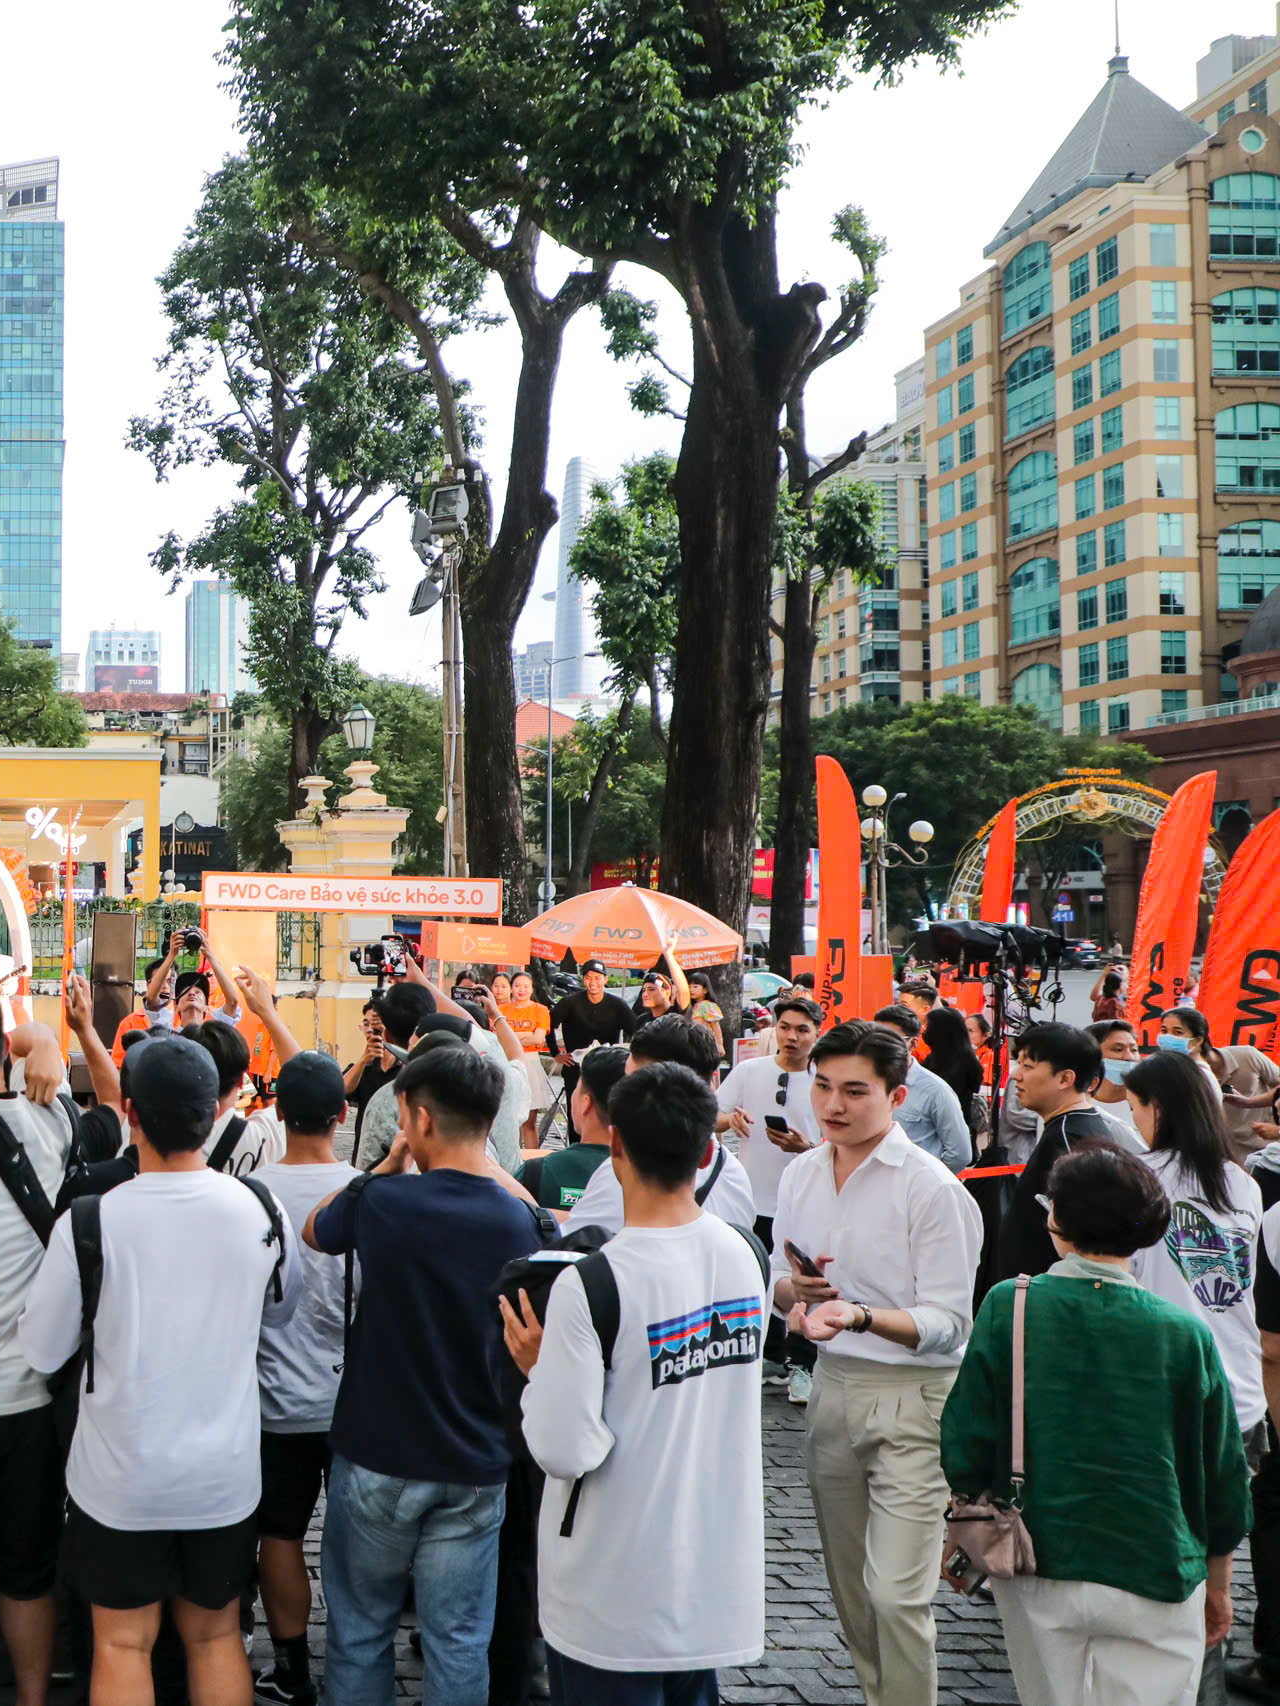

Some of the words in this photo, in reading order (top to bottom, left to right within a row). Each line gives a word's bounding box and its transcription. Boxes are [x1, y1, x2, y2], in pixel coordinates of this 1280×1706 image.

[160, 840, 212, 856] KATINAT
[218, 882, 261, 899] FWD
[264, 883, 306, 900] Care
[311, 883, 343, 901] Bảo
[346, 887, 368, 907] vệ
[371, 887, 401, 903] sức
[405, 885, 450, 904] khỏe
[453, 889, 484, 905] 3.0
[540, 918, 575, 934] FWD
[593, 926, 643, 940] FWD
[659, 1332, 756, 1384] pataonia
